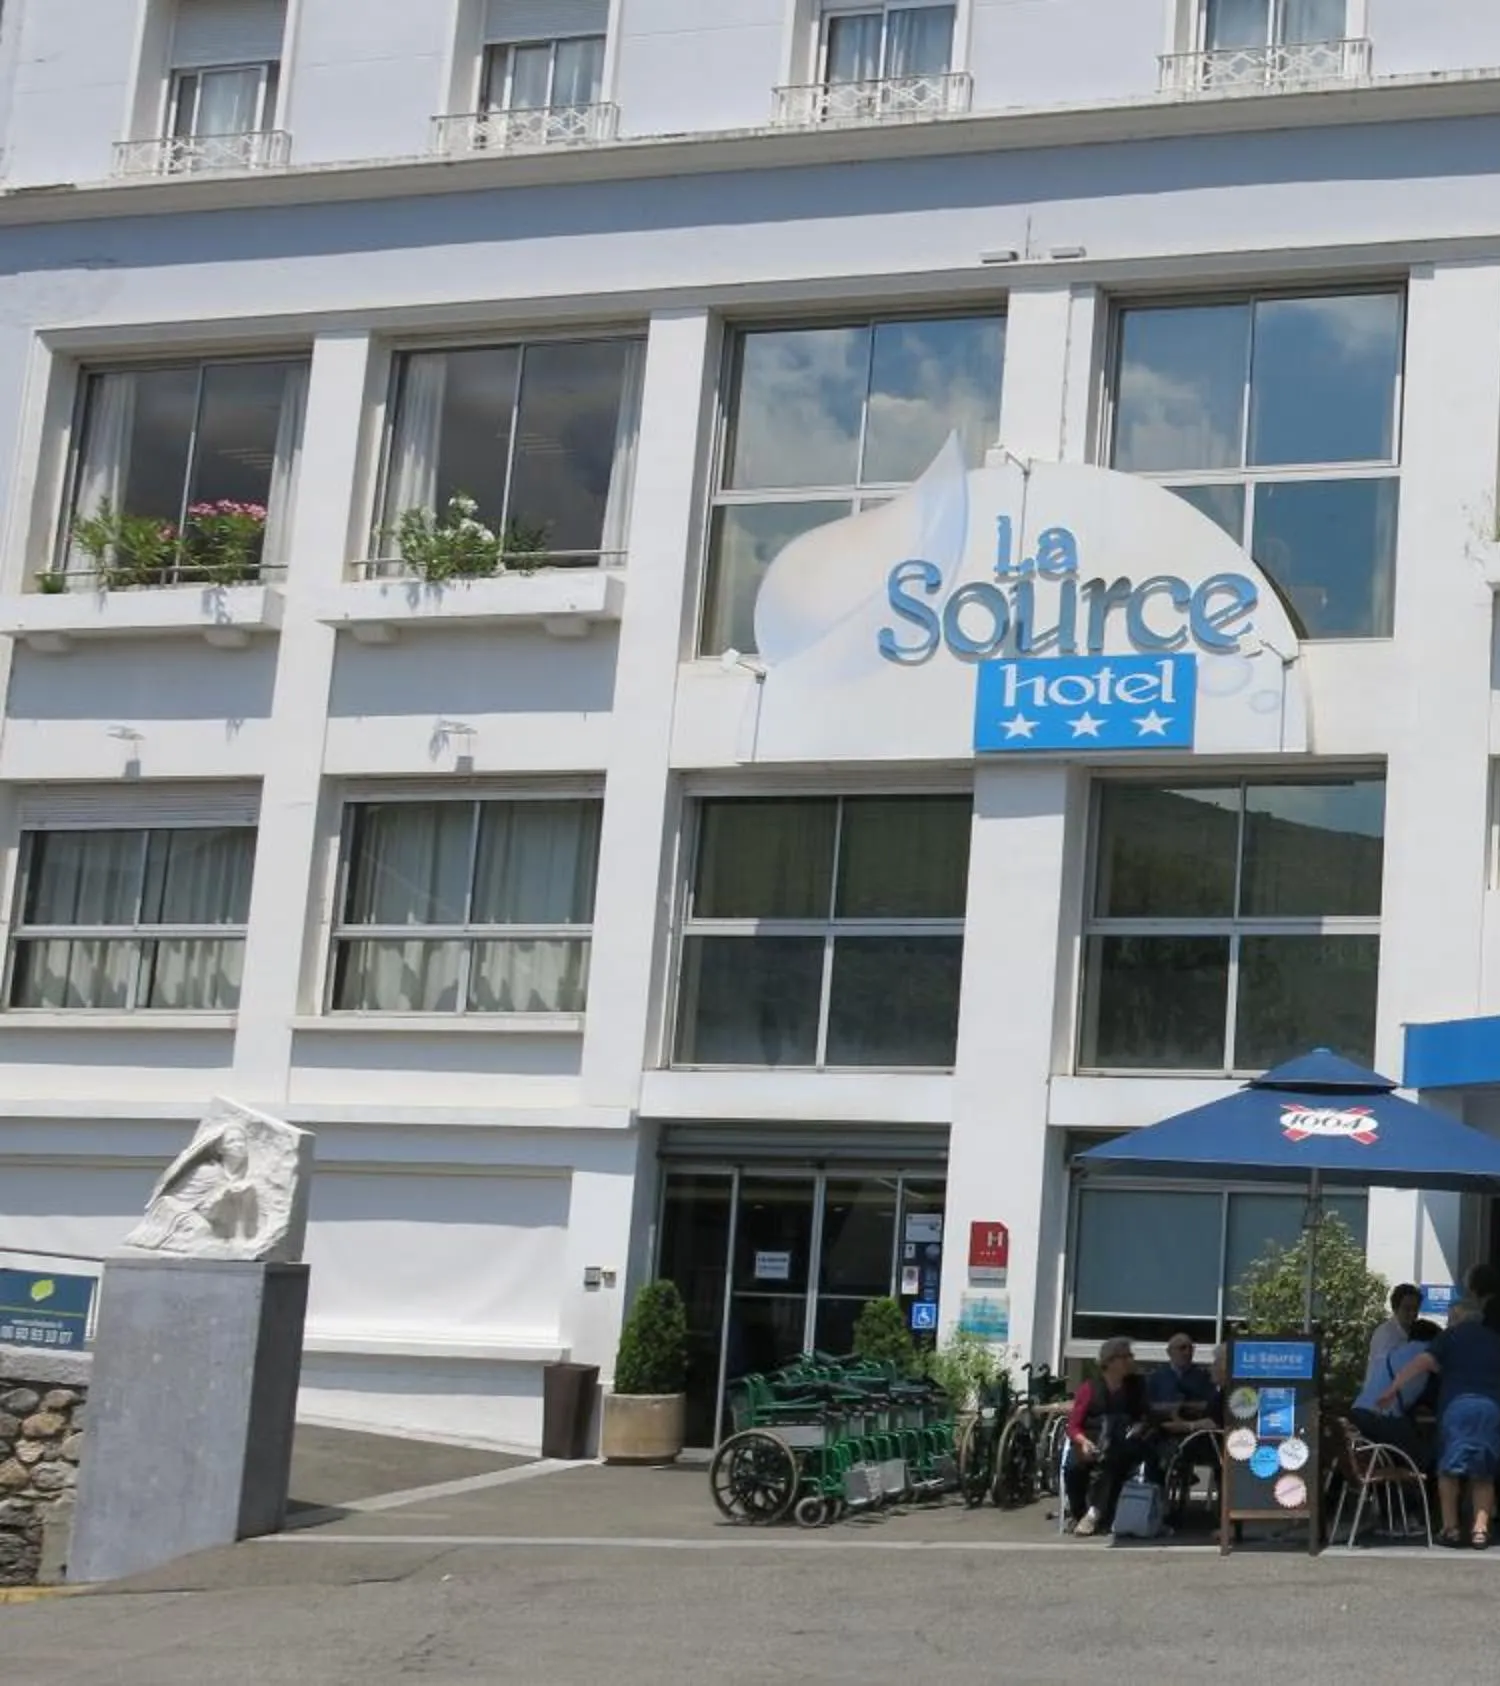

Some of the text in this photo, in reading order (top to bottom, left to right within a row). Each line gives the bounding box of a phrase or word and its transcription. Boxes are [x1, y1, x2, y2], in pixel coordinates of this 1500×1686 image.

[993, 515, 1079, 578] La
[879, 560, 1259, 665] Source
[1000, 660, 1176, 706] hotel
[987, 1231, 1004, 1248] H
